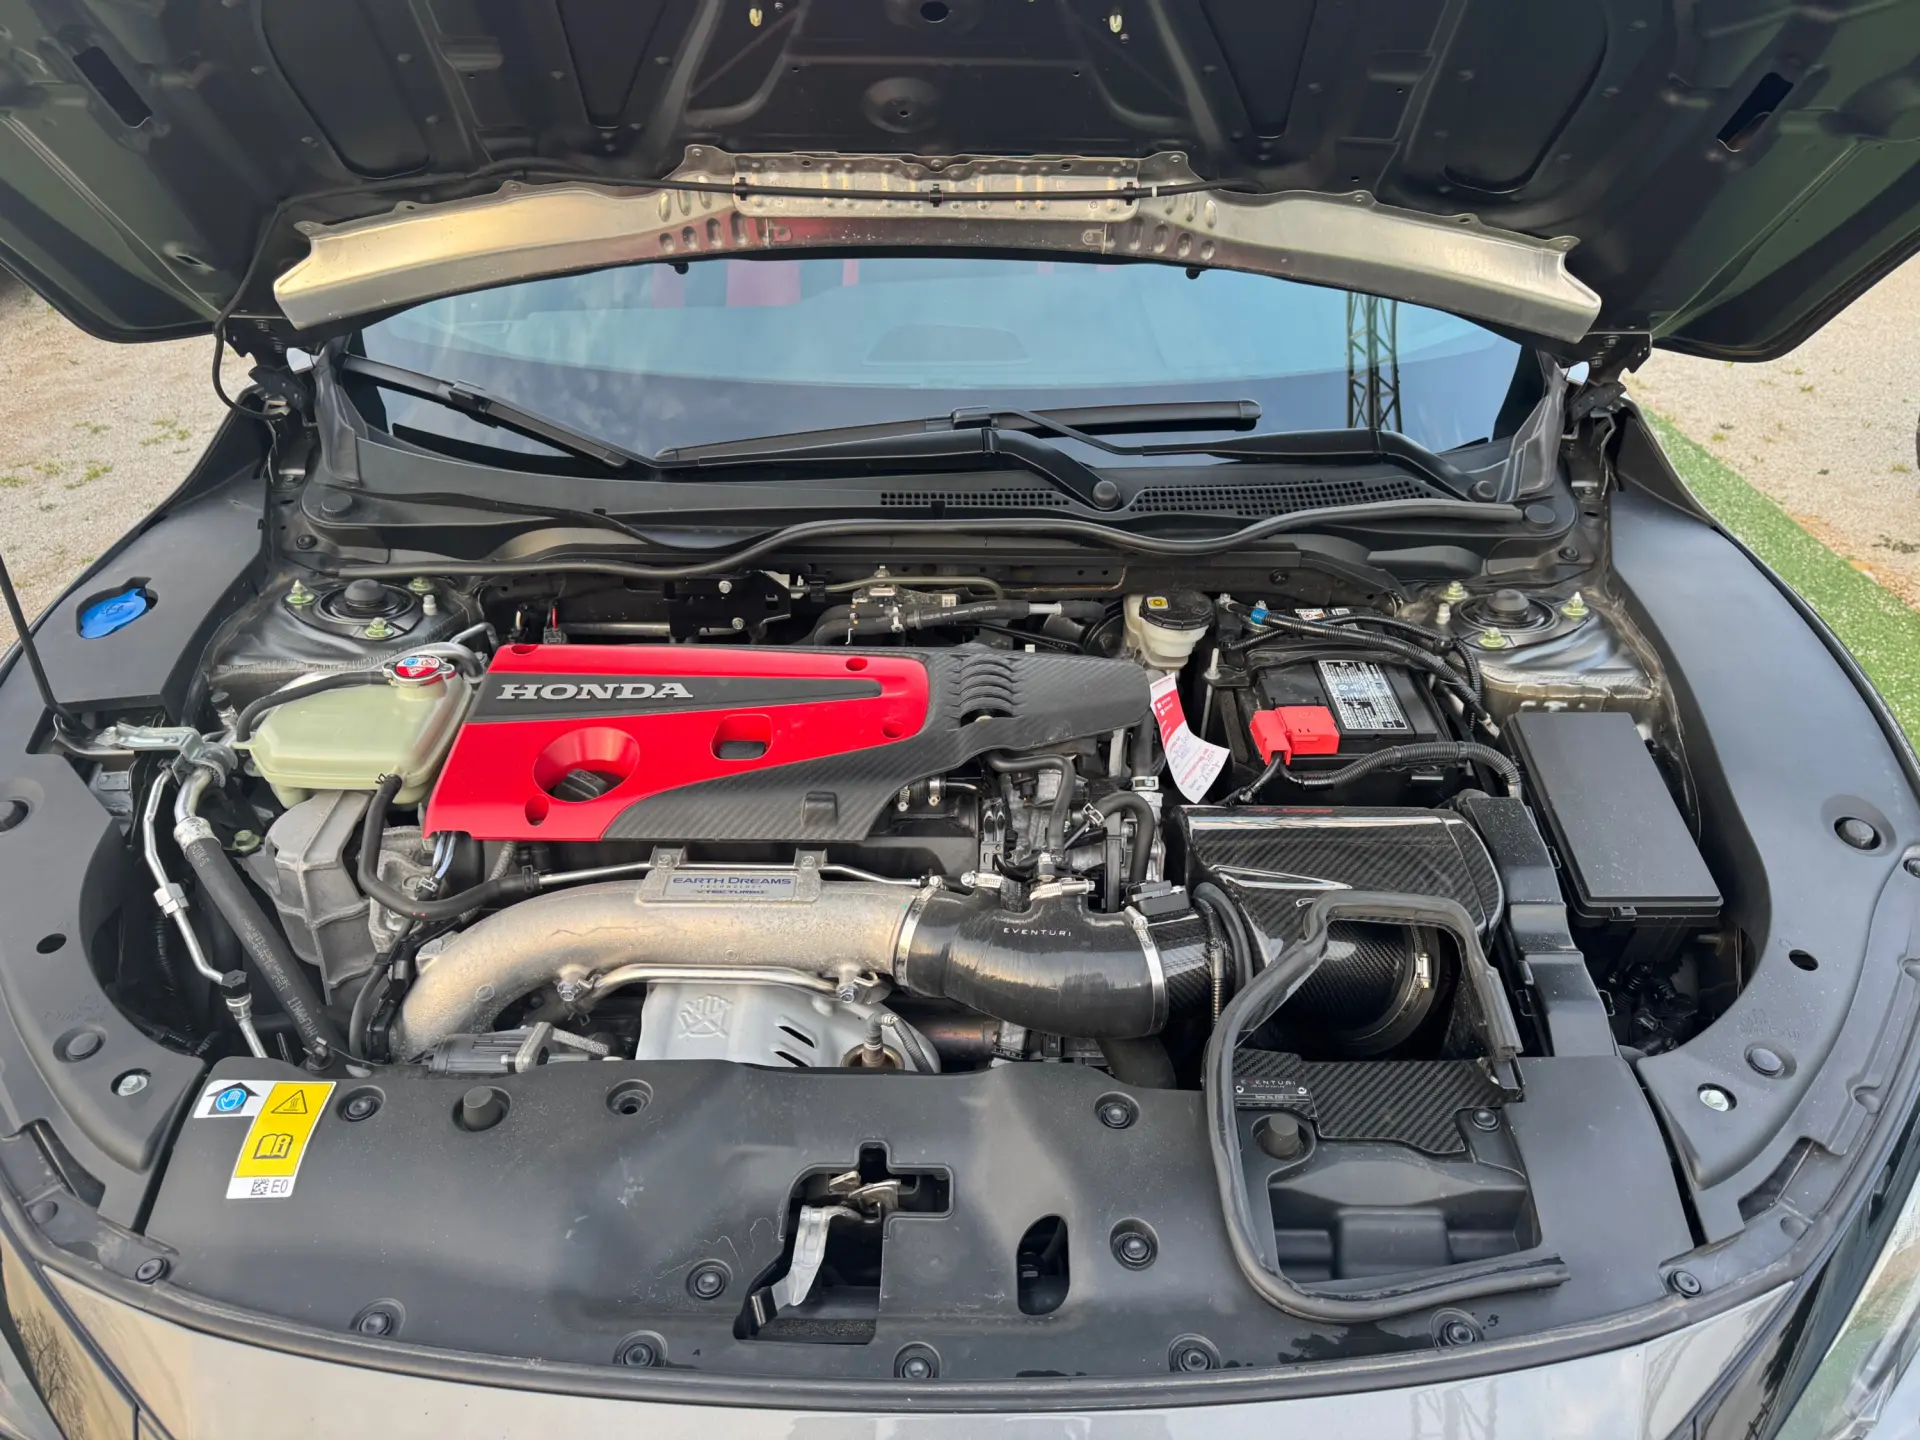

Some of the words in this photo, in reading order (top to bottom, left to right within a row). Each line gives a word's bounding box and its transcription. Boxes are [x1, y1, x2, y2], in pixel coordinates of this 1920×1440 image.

[496, 683, 695, 700] HONDA
[728, 876, 792, 885] DREAMS
[1003, 927, 1072, 937] EVENTURI
